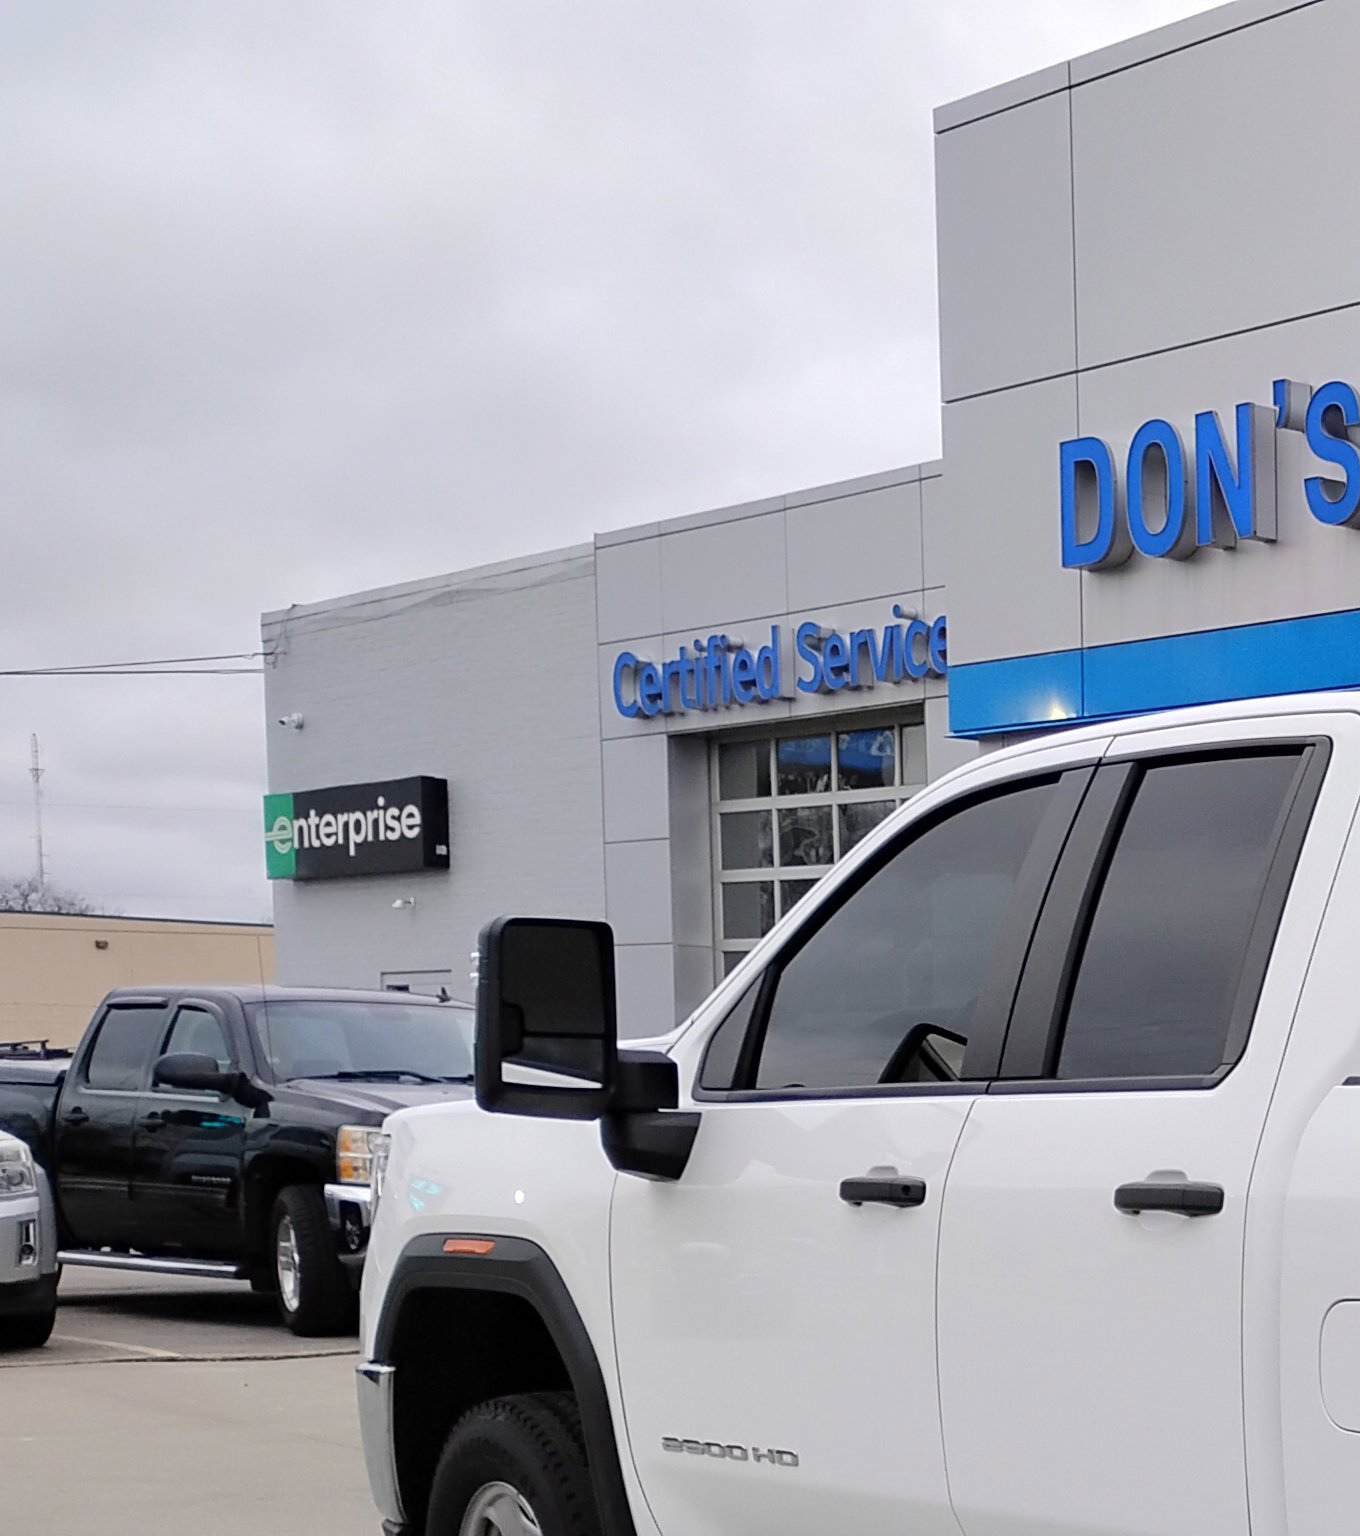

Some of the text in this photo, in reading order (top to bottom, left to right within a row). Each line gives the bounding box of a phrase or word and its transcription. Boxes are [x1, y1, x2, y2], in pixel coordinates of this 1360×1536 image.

[613, 604, 946, 718] Certified Service
[266, 796, 421, 857] enterprise
[752, 1446, 799, 1467] HD
